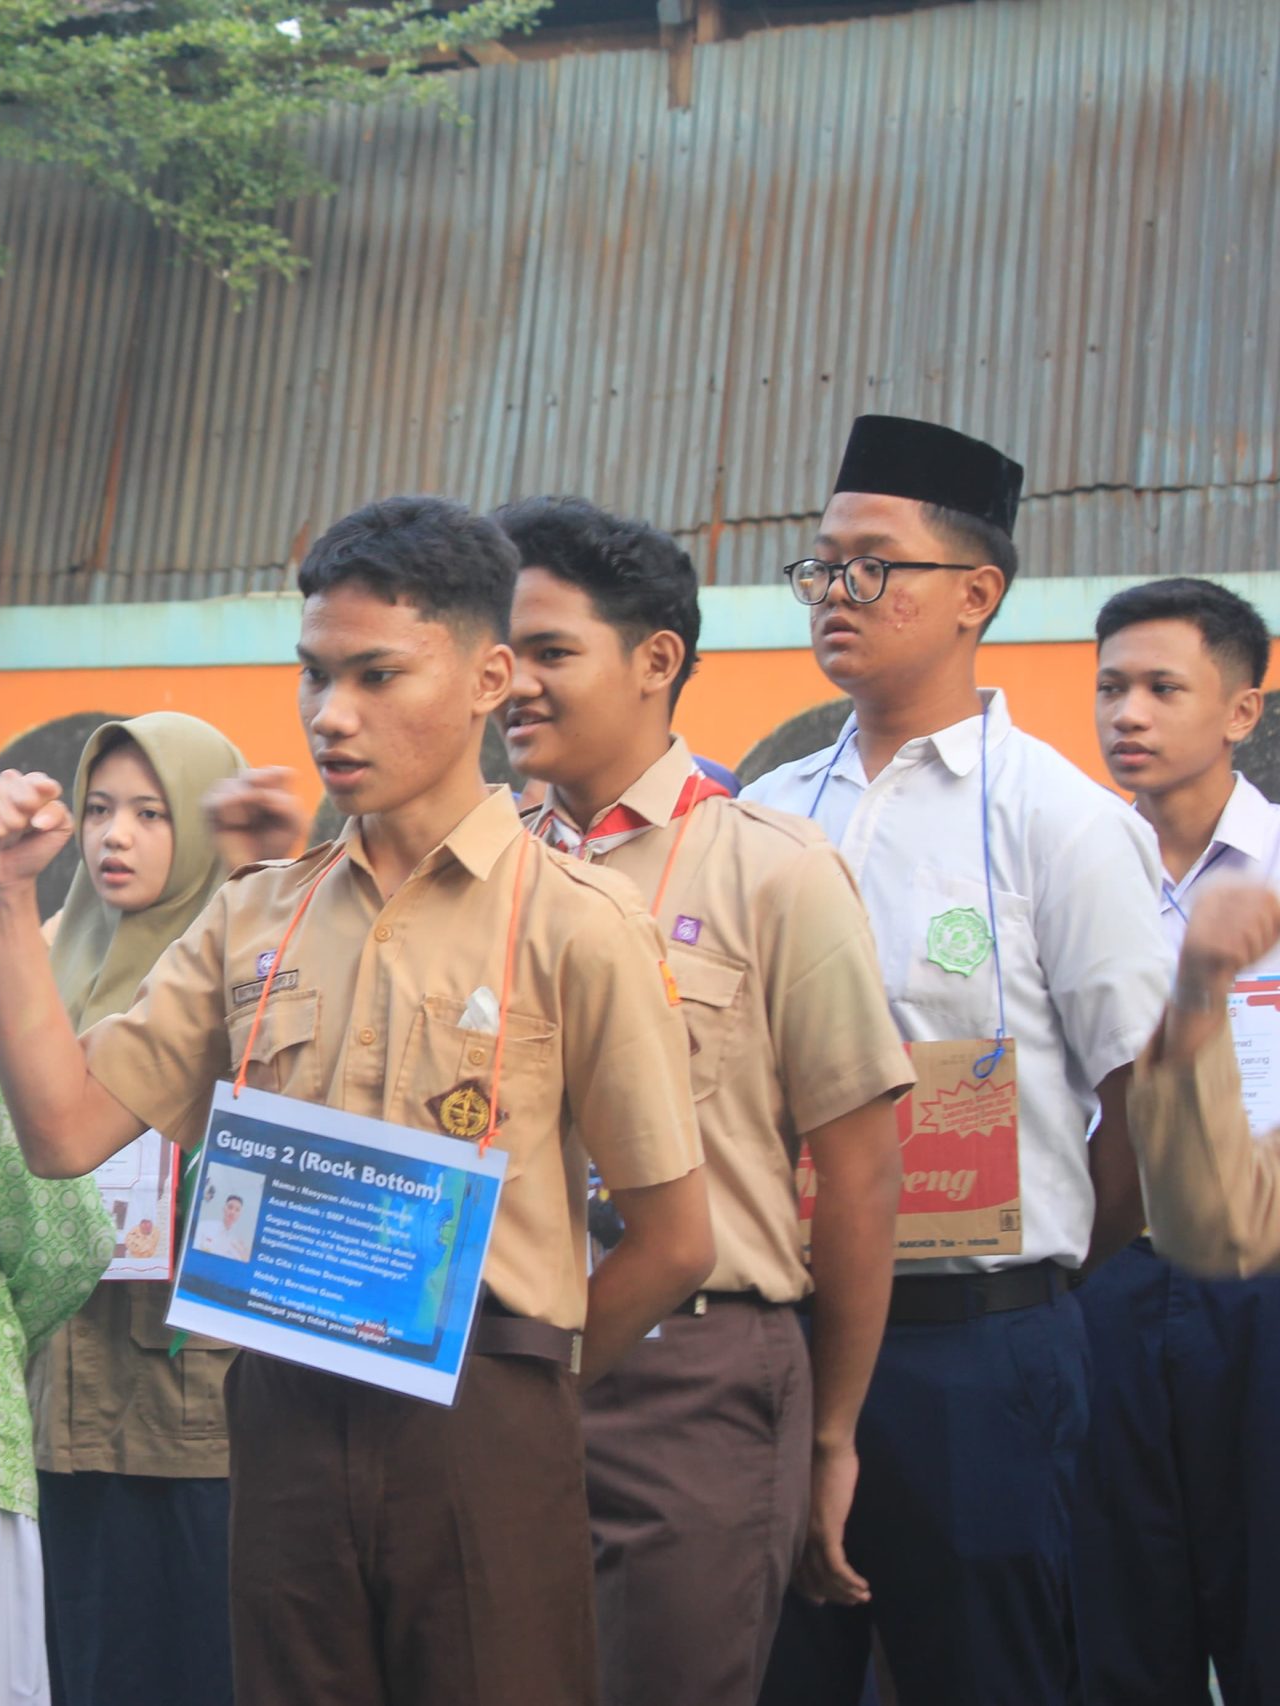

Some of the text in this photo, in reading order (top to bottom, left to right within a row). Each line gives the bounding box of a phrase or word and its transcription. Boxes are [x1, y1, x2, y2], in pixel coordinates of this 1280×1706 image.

[216, 1129, 443, 1205] Gugus 2 (Rock Bottom)
[288, 1201, 319, 1215] Sekolah
[326, 1211, 344, 1222] SMP
[261, 1235, 304, 1254] bagaimana
[306, 1249, 323, 1258] cara
[265, 1214, 290, 1227] Gugus
[292, 1221, 320, 1234] Quotes
[393, 1248, 416, 1259] dunia
[315, 1240, 334, 1249] cara
[371, 1254, 388, 1265] ajari
[390, 1259, 413, 1270] dunia
[254, 1270, 278, 1284] Hobby
[284, 1278, 317, 1294] Bermain
[257, 1252, 273, 1264] Cita
[275, 1257, 291, 1268] Cita
[298, 1263, 320, 1276] Game
[322, 1270, 362, 1289] Developer
[250, 1288, 272, 1300] Motto
[247, 1299, 285, 1317] semangat
[286, 1310, 305, 1322] yang
[307, 1315, 326, 1327] tidak
[328, 1321, 356, 1336] pernah
